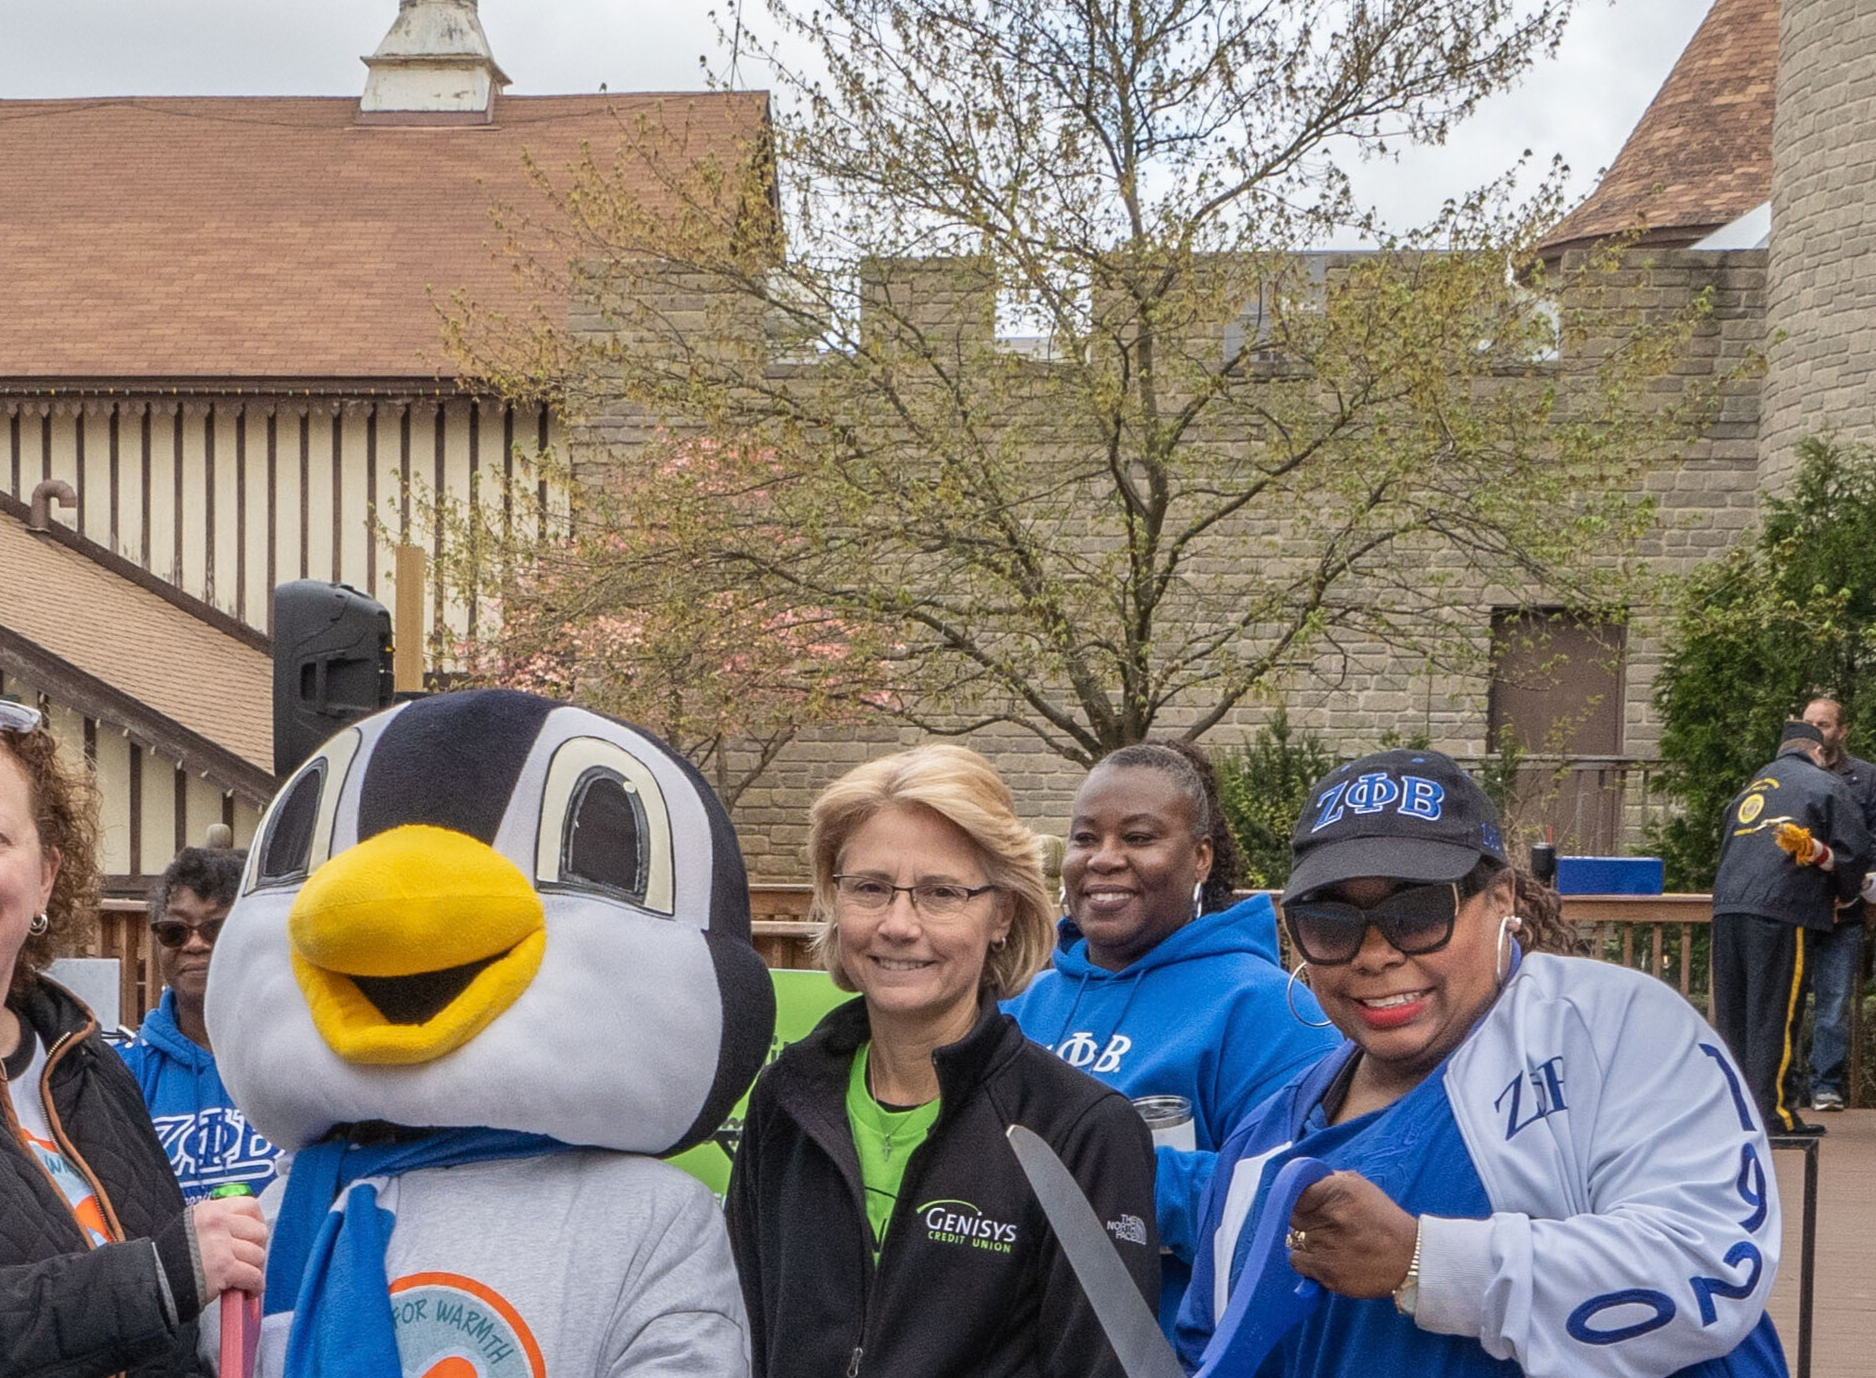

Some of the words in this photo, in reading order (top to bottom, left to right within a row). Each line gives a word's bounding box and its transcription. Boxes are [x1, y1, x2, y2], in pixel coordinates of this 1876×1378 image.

[1106, 1220, 1136, 1232] NORTH
[928, 1231, 966, 1245] CREDIT
[972, 1238, 1012, 1254] UNION
[436, 1299, 514, 1365] WARMTH
